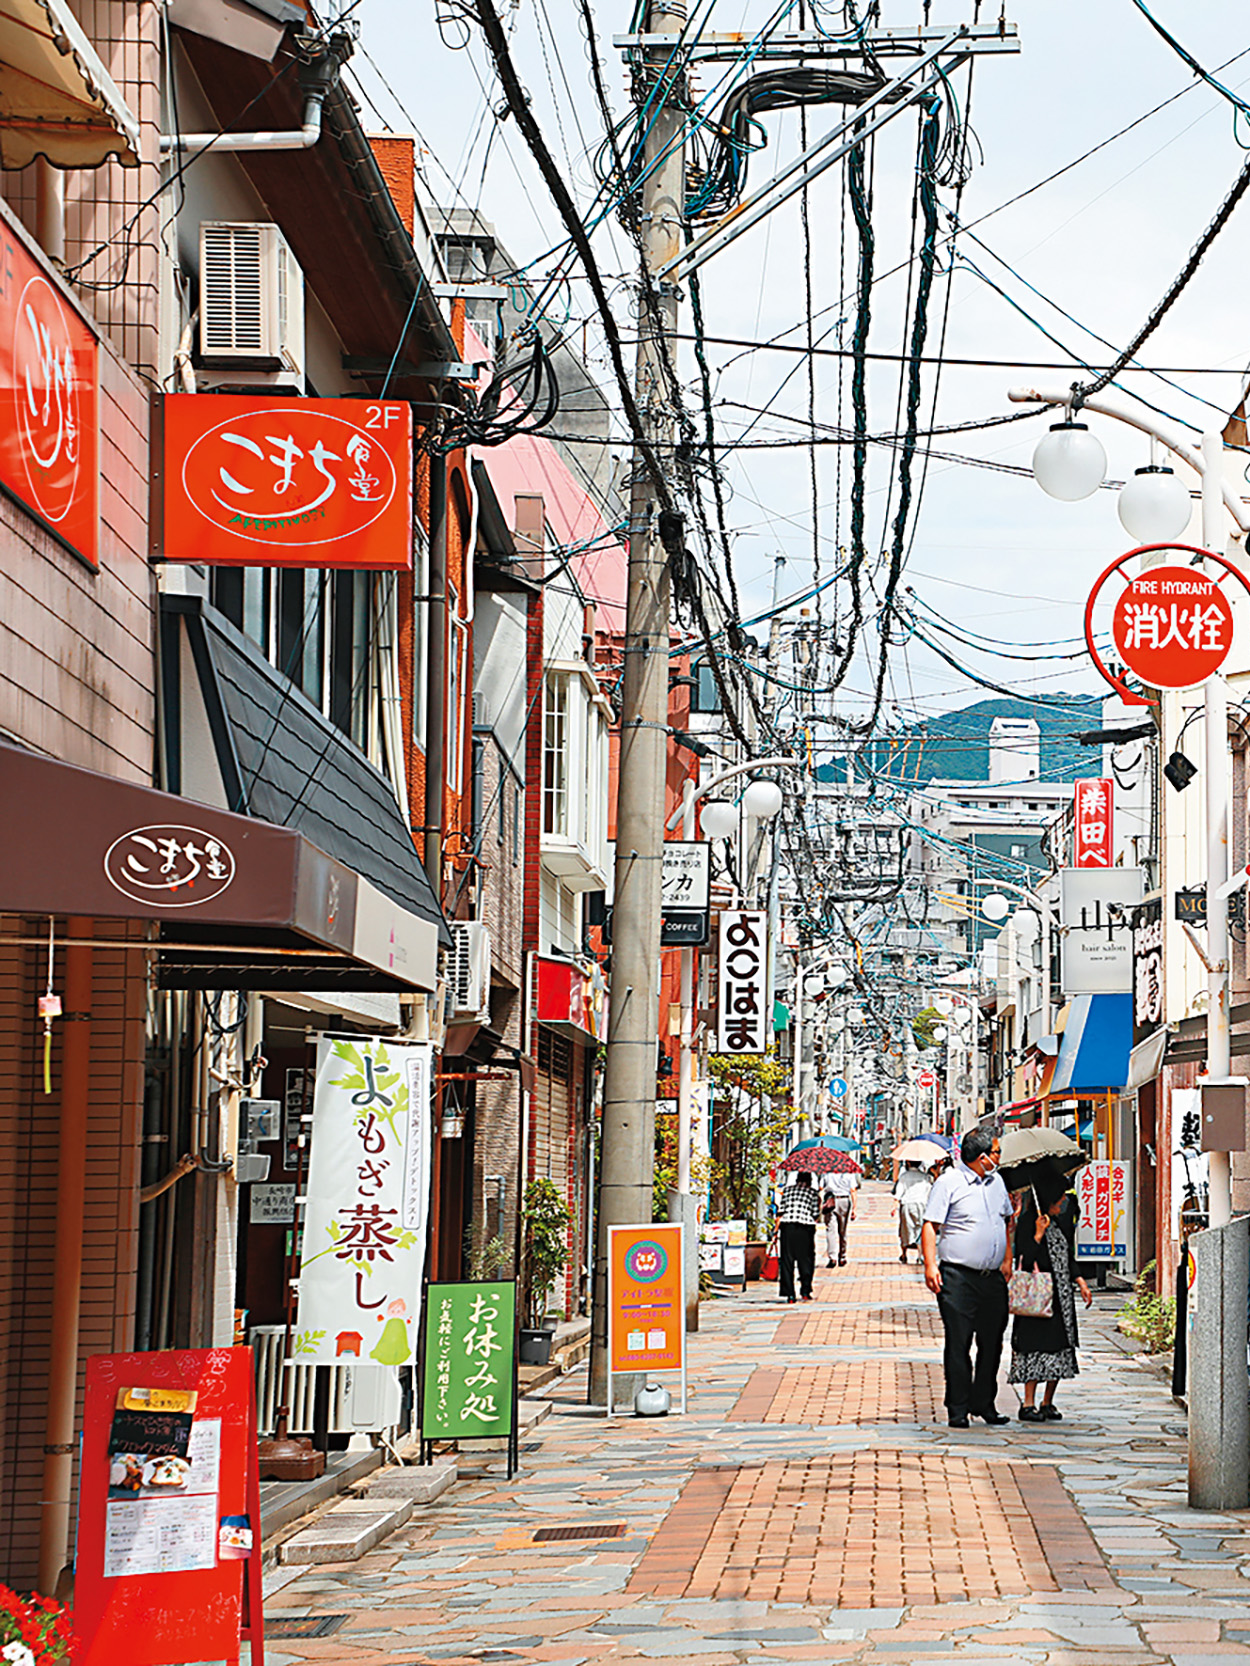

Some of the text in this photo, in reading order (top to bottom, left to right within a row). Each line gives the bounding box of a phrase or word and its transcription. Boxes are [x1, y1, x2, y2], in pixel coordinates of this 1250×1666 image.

[365, 405, 401, 429] 2F
[211, 432, 343, 517] こまち
[1132, 581, 1214, 595] FIRE HYDRANT
[1123, 603, 1226, 650] 消火栓
[666, 923, 698, 931] COFFEE
[725, 914, 760, 1049] よこはま
[334, 1055, 399, 1309] よもぎ蒸し
[1081, 1166, 1094, 1228] 人形ケース
[1112, 1166, 1125, 1203] 合カギ
[460, 1293, 503, 1422] お休み処
